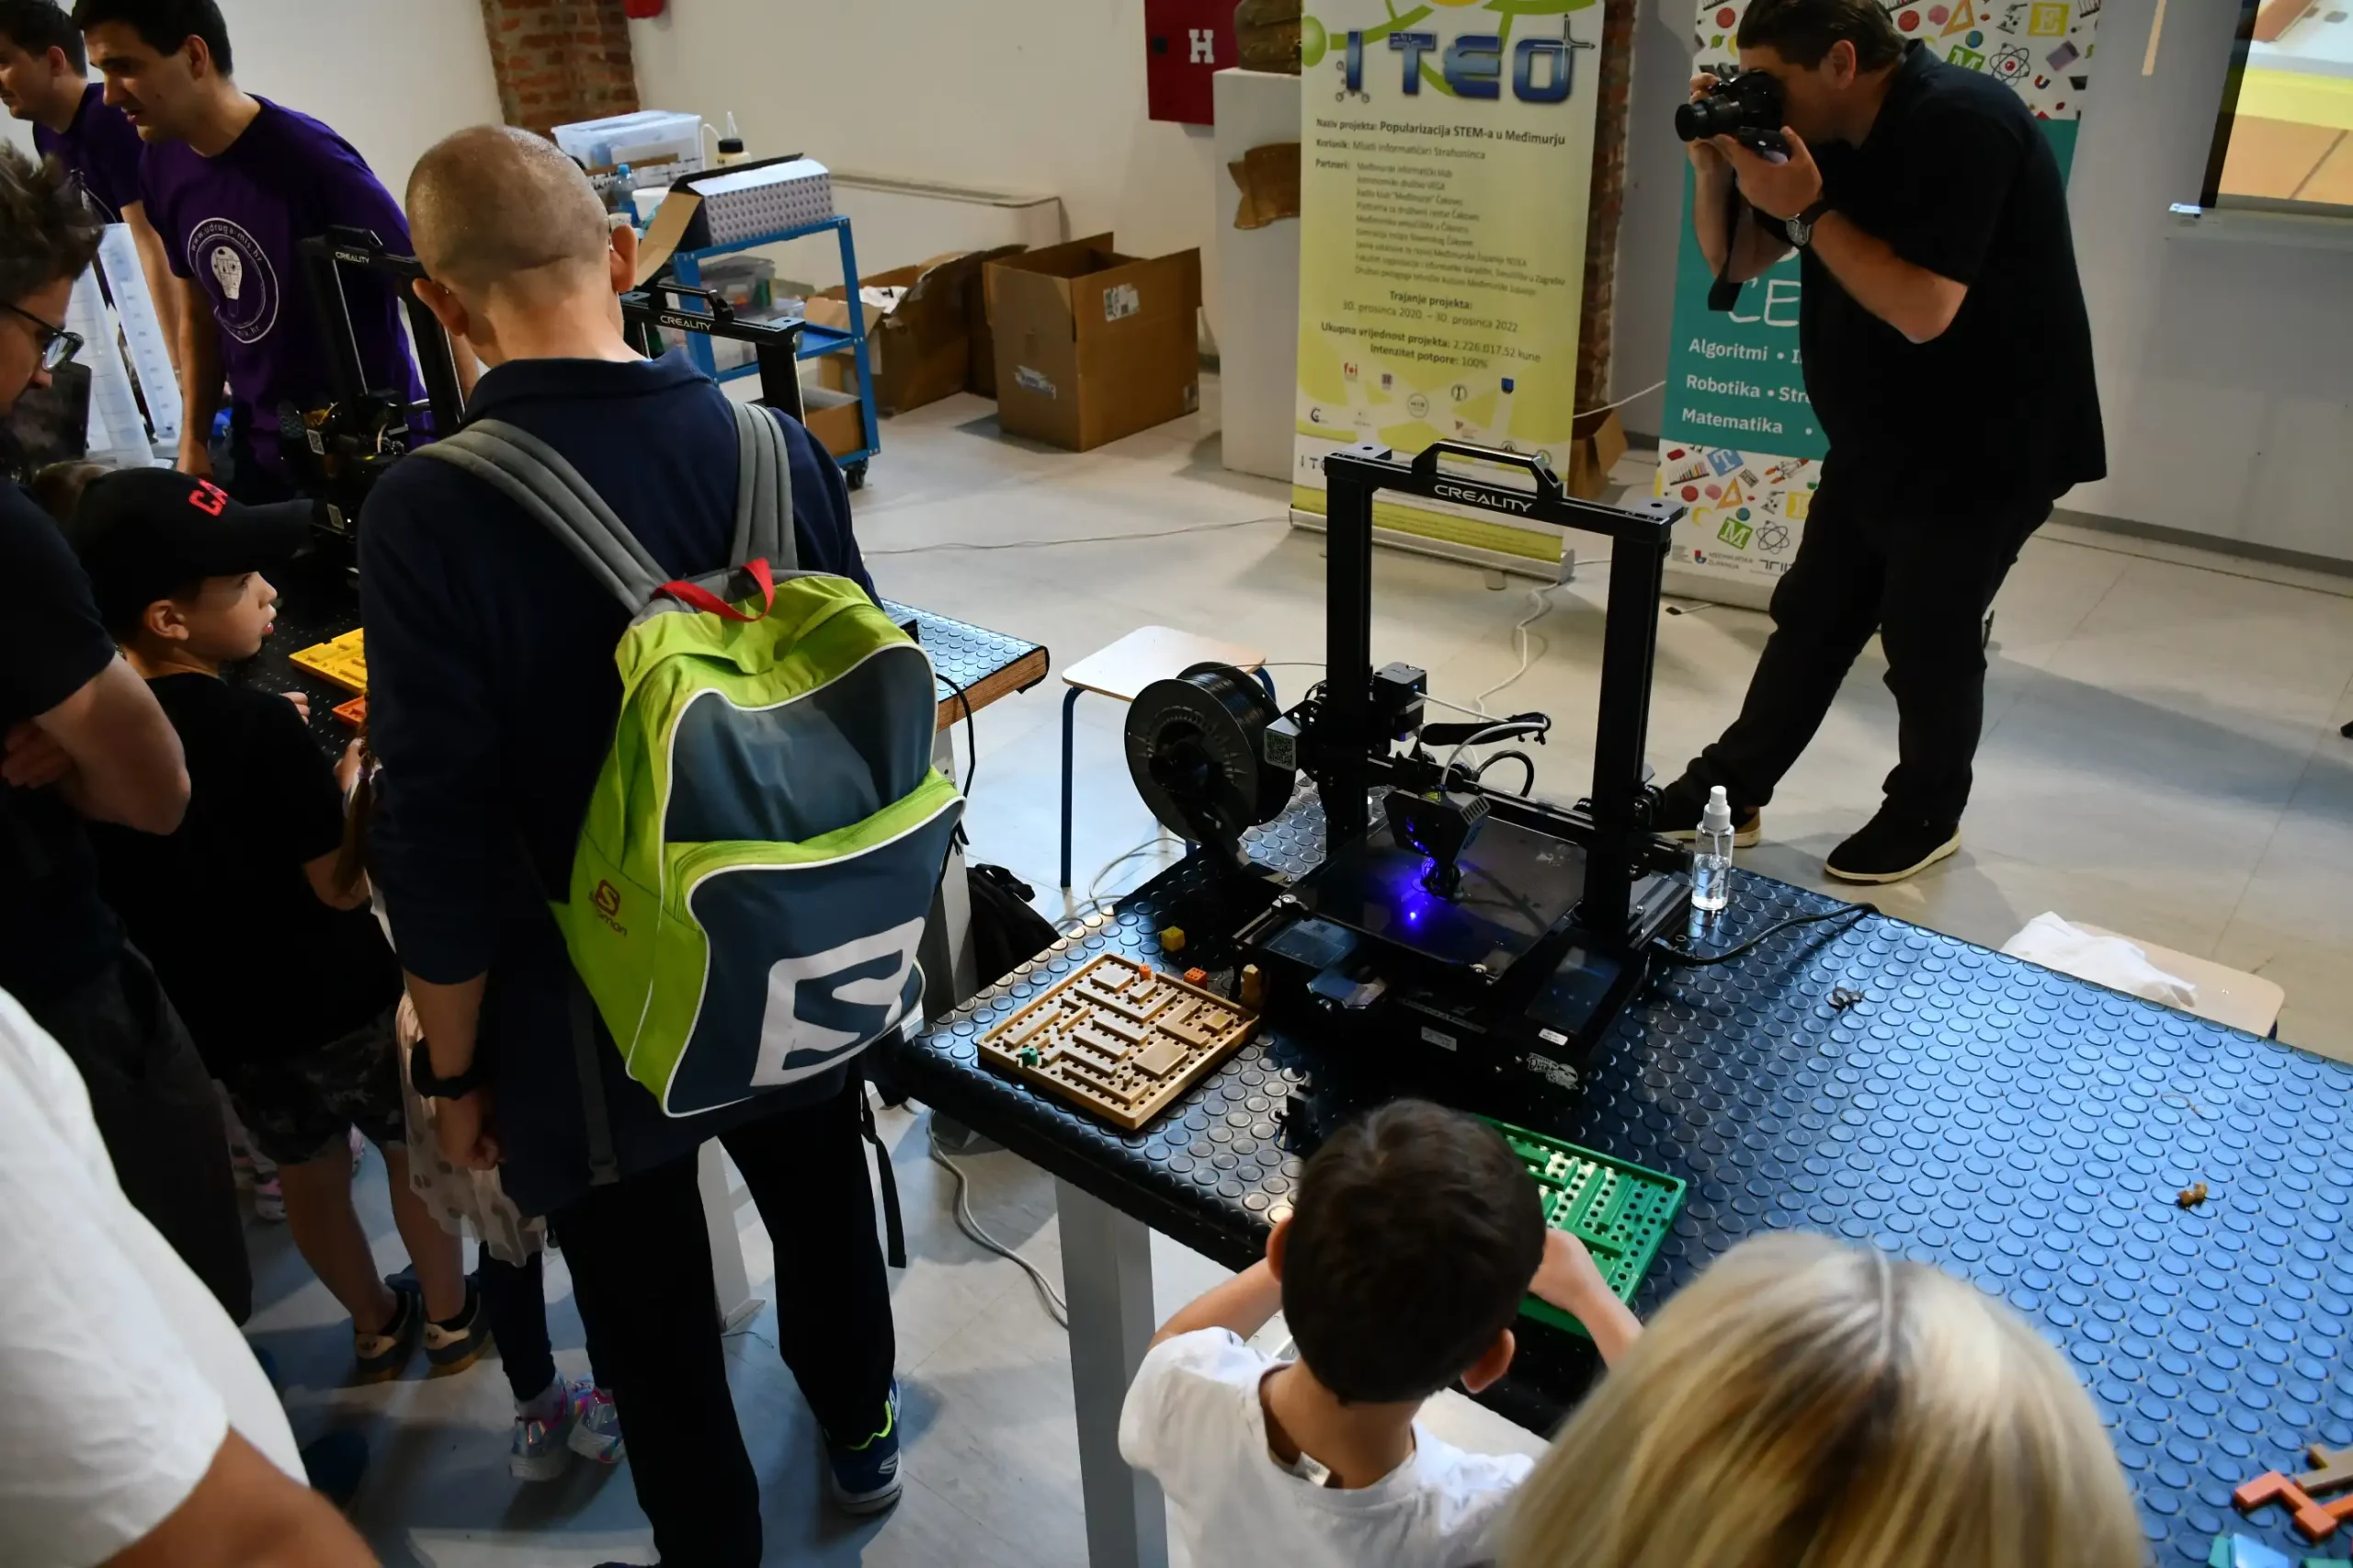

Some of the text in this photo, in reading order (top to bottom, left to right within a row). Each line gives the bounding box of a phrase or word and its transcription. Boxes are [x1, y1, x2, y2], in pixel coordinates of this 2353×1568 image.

[1188, 28, 1214, 64] H
[1339, 120, 1377, 131] projekta:
[1380, 120, 1450, 138] Popularizacija
[1453, 125, 1494, 139] STEM-a
[1495, 131, 1503, 140] u
[1505, 130, 1566, 147] Međimurju
[1315, 158, 1350, 169] Partneri:
[335, 251, 369, 264] CREALITY
[1390, 290, 1472, 310] Trajanje projekta:
[659, 314, 711, 331] CREALITY
[1358, 303, 1396, 316] prosinca
[1452, 315, 1493, 328] prosinca
[1321, 321, 1357, 335] Ukupna
[1358, 327, 1405, 342] vrijednost
[1407, 335, 1449, 348] projekta:
[1518, 348, 1541, 363] kune
[1688, 337, 1802, 365] Algoritmi I
[1370, 344, 1489, 369] Intenzitet potpore: 100%
[1686, 374, 1760, 398] Robotika
[1681, 407, 1783, 435] Matematika
[1434, 483, 1533, 513] CREALITY
